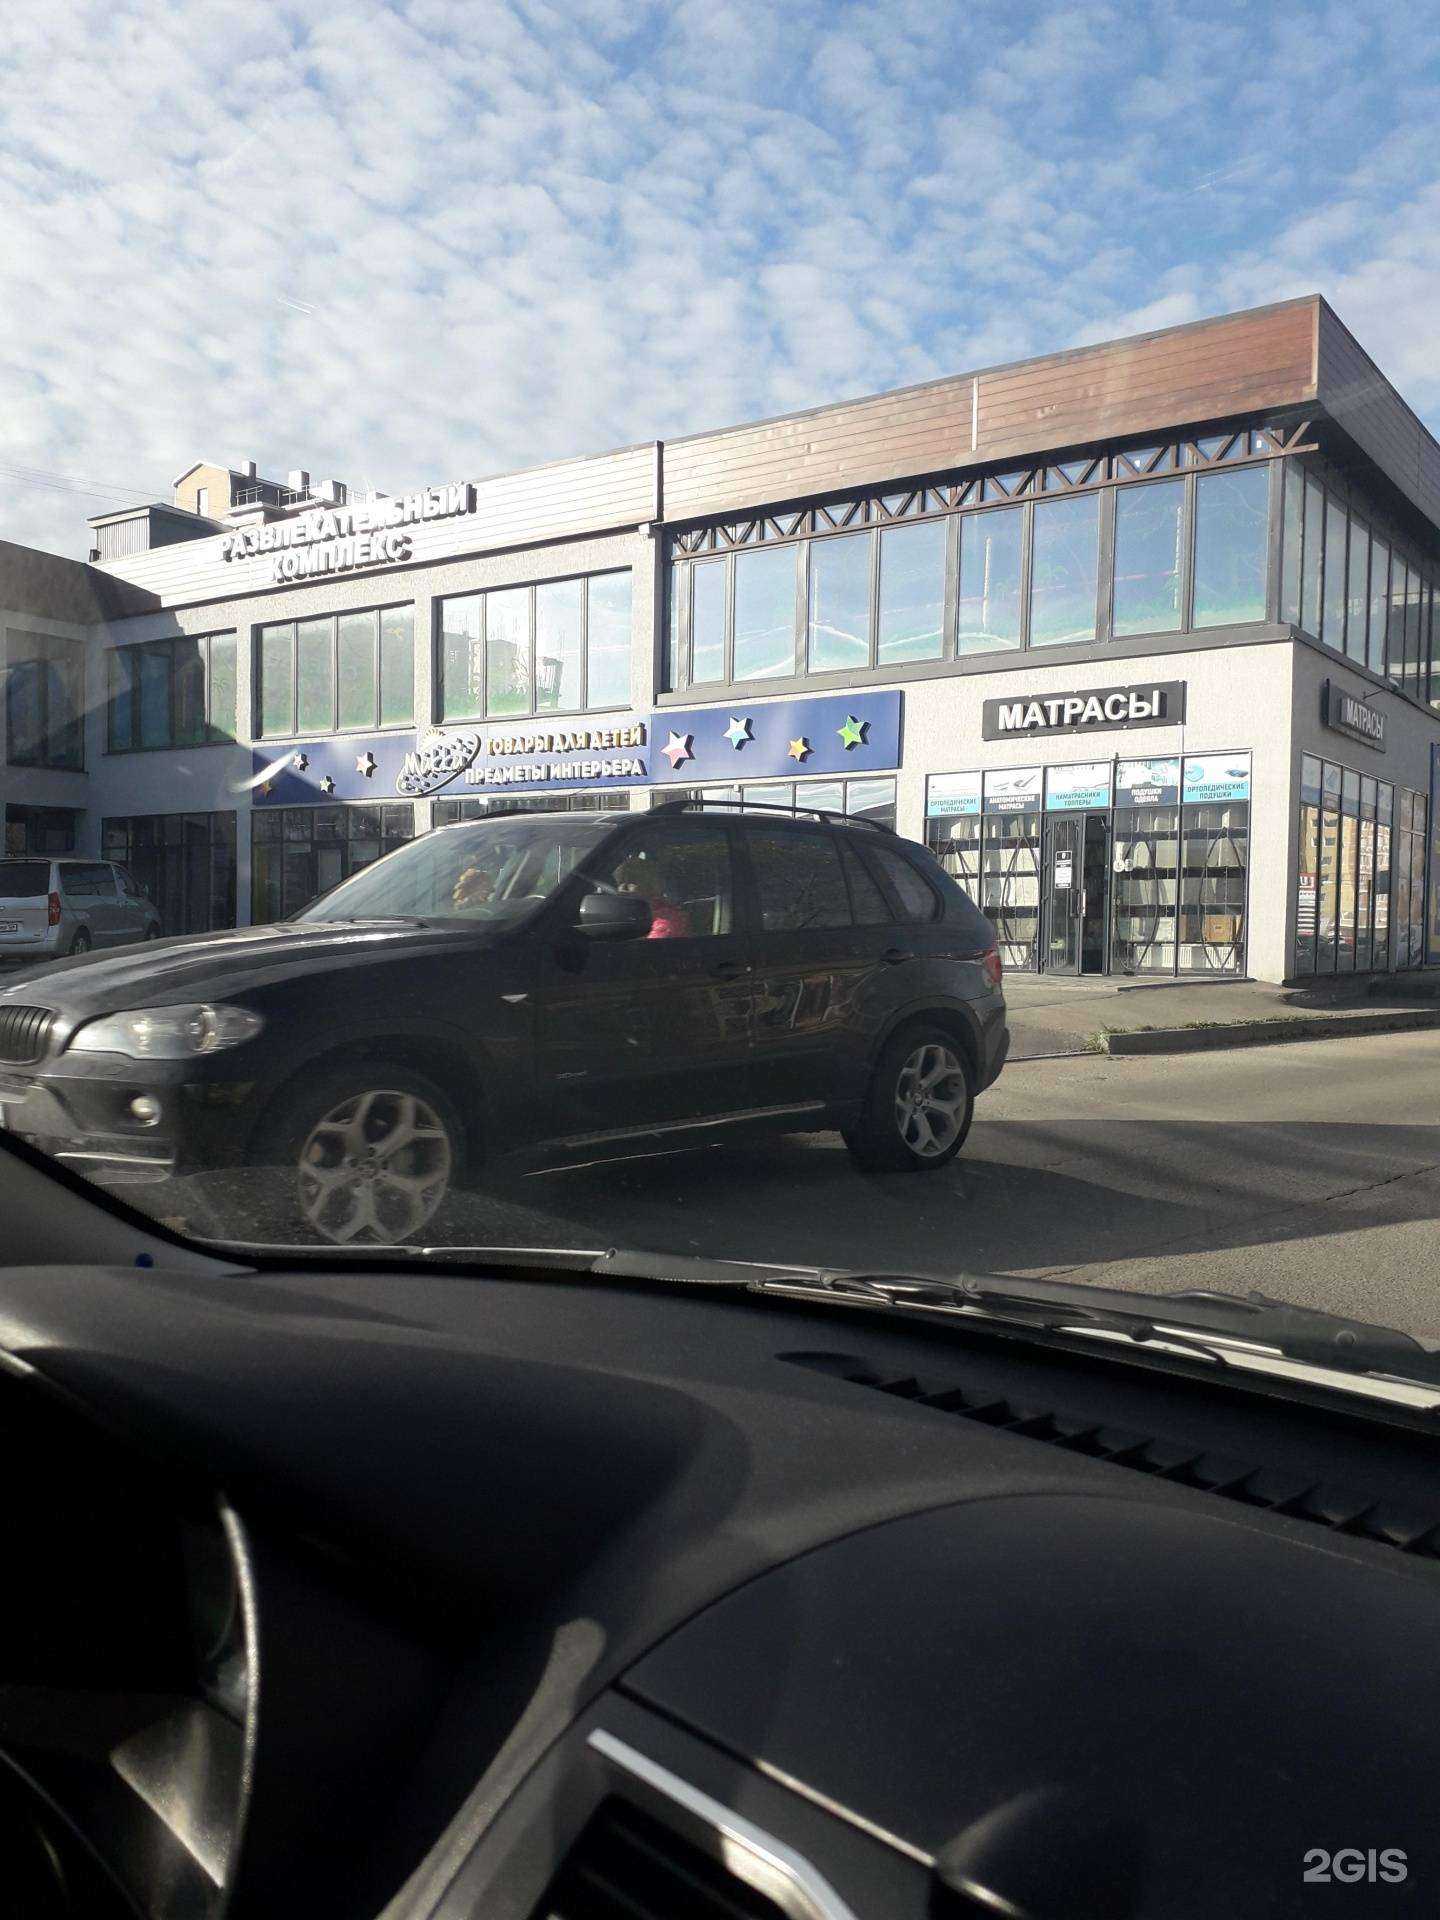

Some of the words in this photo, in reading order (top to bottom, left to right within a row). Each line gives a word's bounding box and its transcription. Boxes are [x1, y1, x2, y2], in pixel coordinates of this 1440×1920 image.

[271, 533, 412, 583] КОМПЛЕКС
[998, 689, 1166, 731] МАТРАСЫ
[1346, 697, 1384, 740] МАТРАСЫ
[487, 735, 549, 755] ТОВАРЫ
[552, 732, 586, 752] ДЛЯ
[588, 722, 647, 750] ДЕТЕЙ
[465, 762, 548, 784] ПРЕДМЕТЫ
[549, 758, 648, 780] ИНТЕРЬЕРА
[1187, 783, 1246, 793] ОРТОПЕДИЧЕСКИЕ
[1199, 791, 1232, 800] ПОДУШКИ
